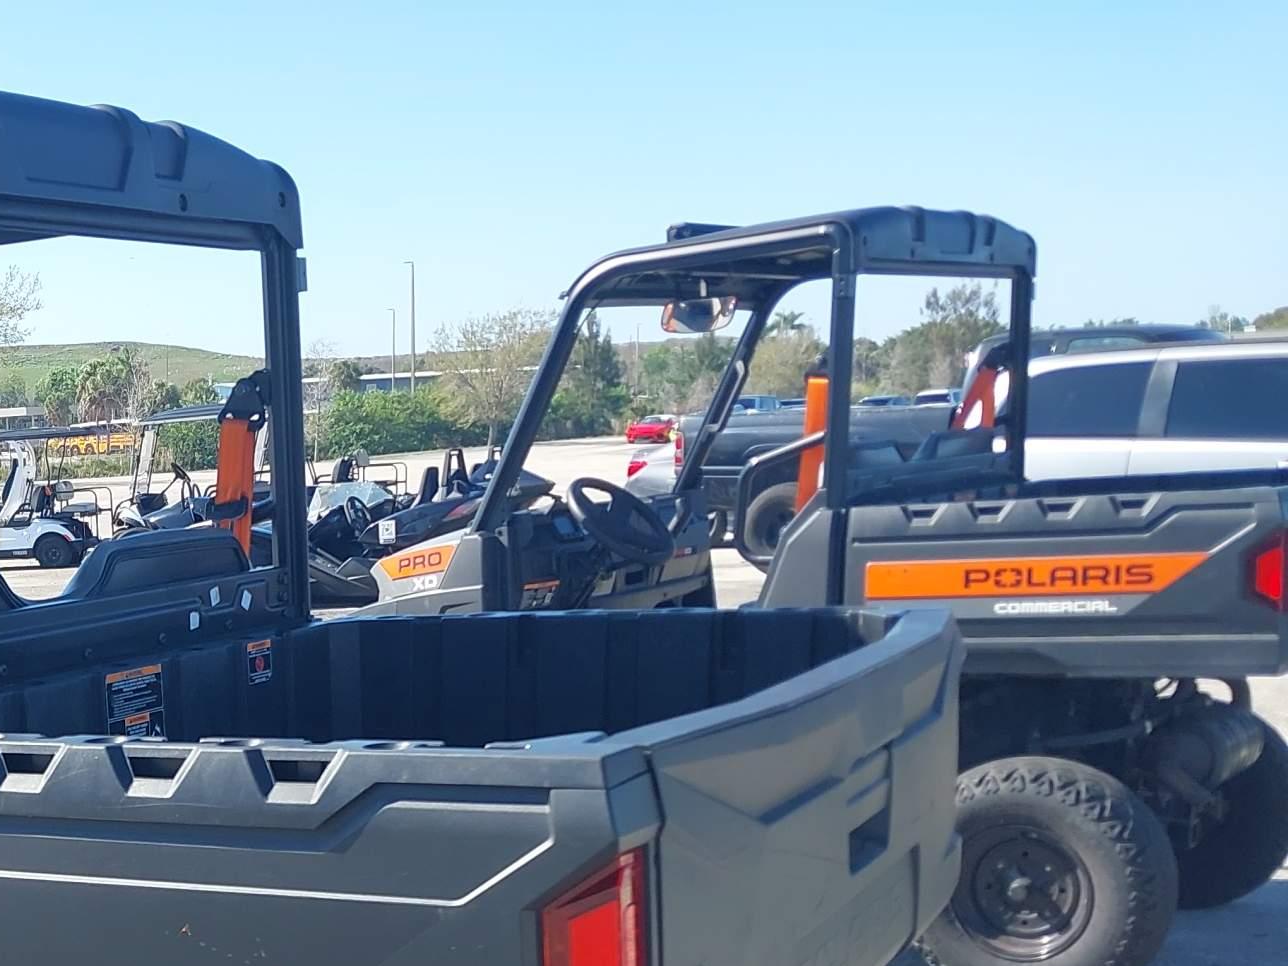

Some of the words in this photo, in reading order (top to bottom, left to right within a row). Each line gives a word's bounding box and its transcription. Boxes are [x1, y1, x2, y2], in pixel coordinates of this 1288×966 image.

[399, 551, 442, 573] PRO
[411, 575, 438, 592] XD
[964, 563, 1154, 589] POLARIS
[992, 600, 1119, 615] COMMERCIAL
